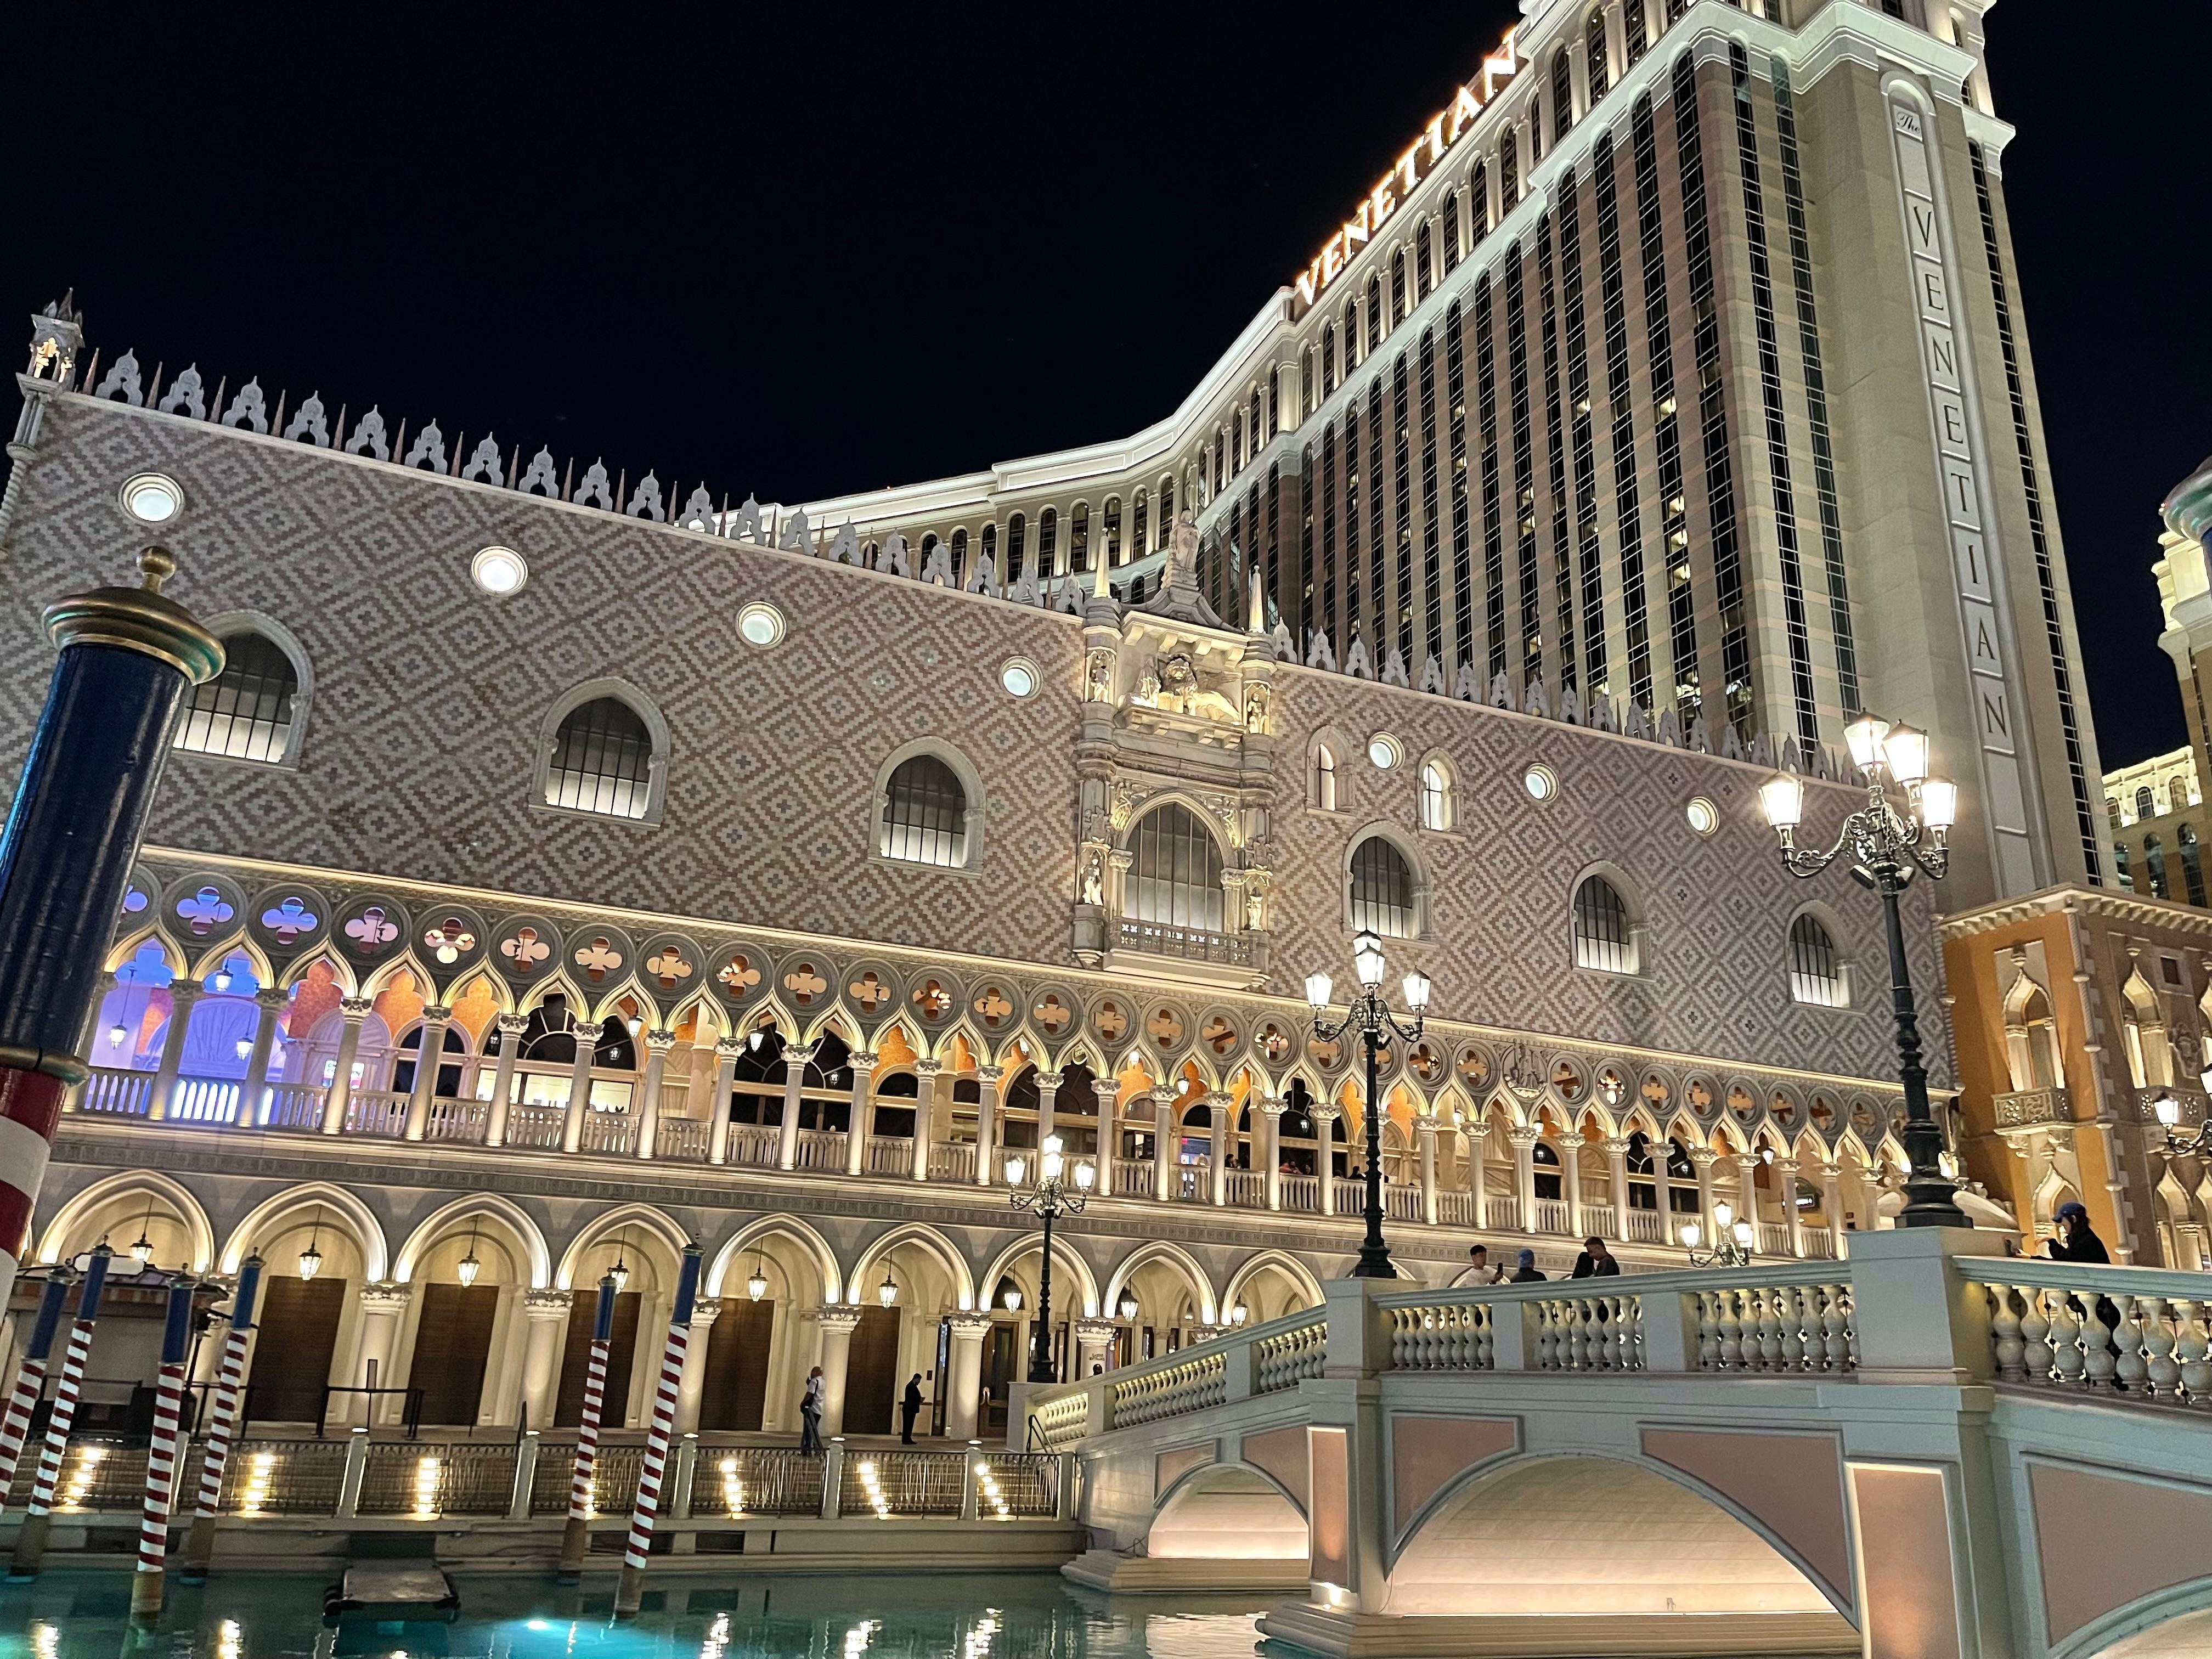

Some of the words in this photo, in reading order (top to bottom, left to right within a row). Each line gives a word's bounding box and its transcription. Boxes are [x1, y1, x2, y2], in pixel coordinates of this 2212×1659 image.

[1296, 26, 1519, 306] VENETIAN
[1896, 111, 1920, 133] The
[1913, 205, 2007, 738] VENETIAN
